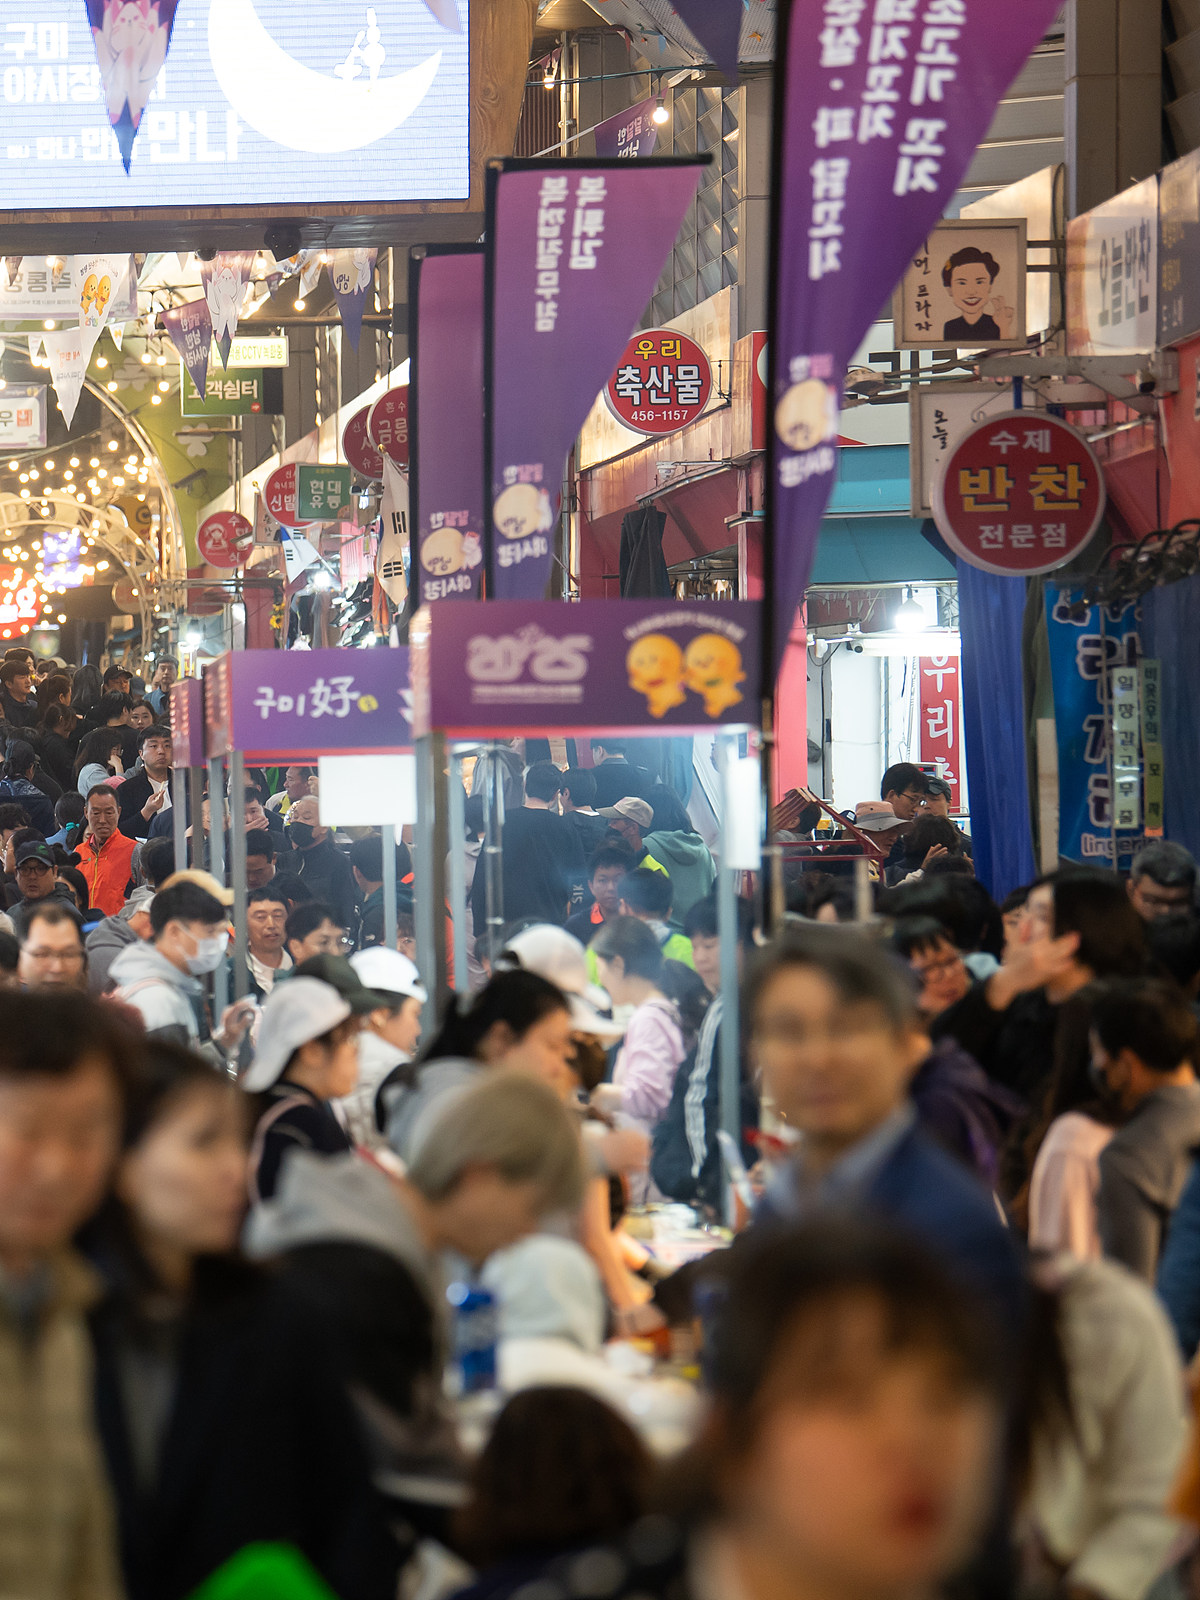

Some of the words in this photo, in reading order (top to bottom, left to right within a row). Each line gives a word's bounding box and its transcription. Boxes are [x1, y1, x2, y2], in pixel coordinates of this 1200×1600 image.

[3, 22, 69, 59] 구미
[149, 110, 244, 162] 만나
[633, 339, 682, 360] 우리
[615, 364, 703, 406] 축산물
[631, 410, 688, 421] 456-1157
[989, 429, 1051, 454] 수제
[959, 463, 1087, 513] 반찬
[978, 523, 1067, 549] 전문점
